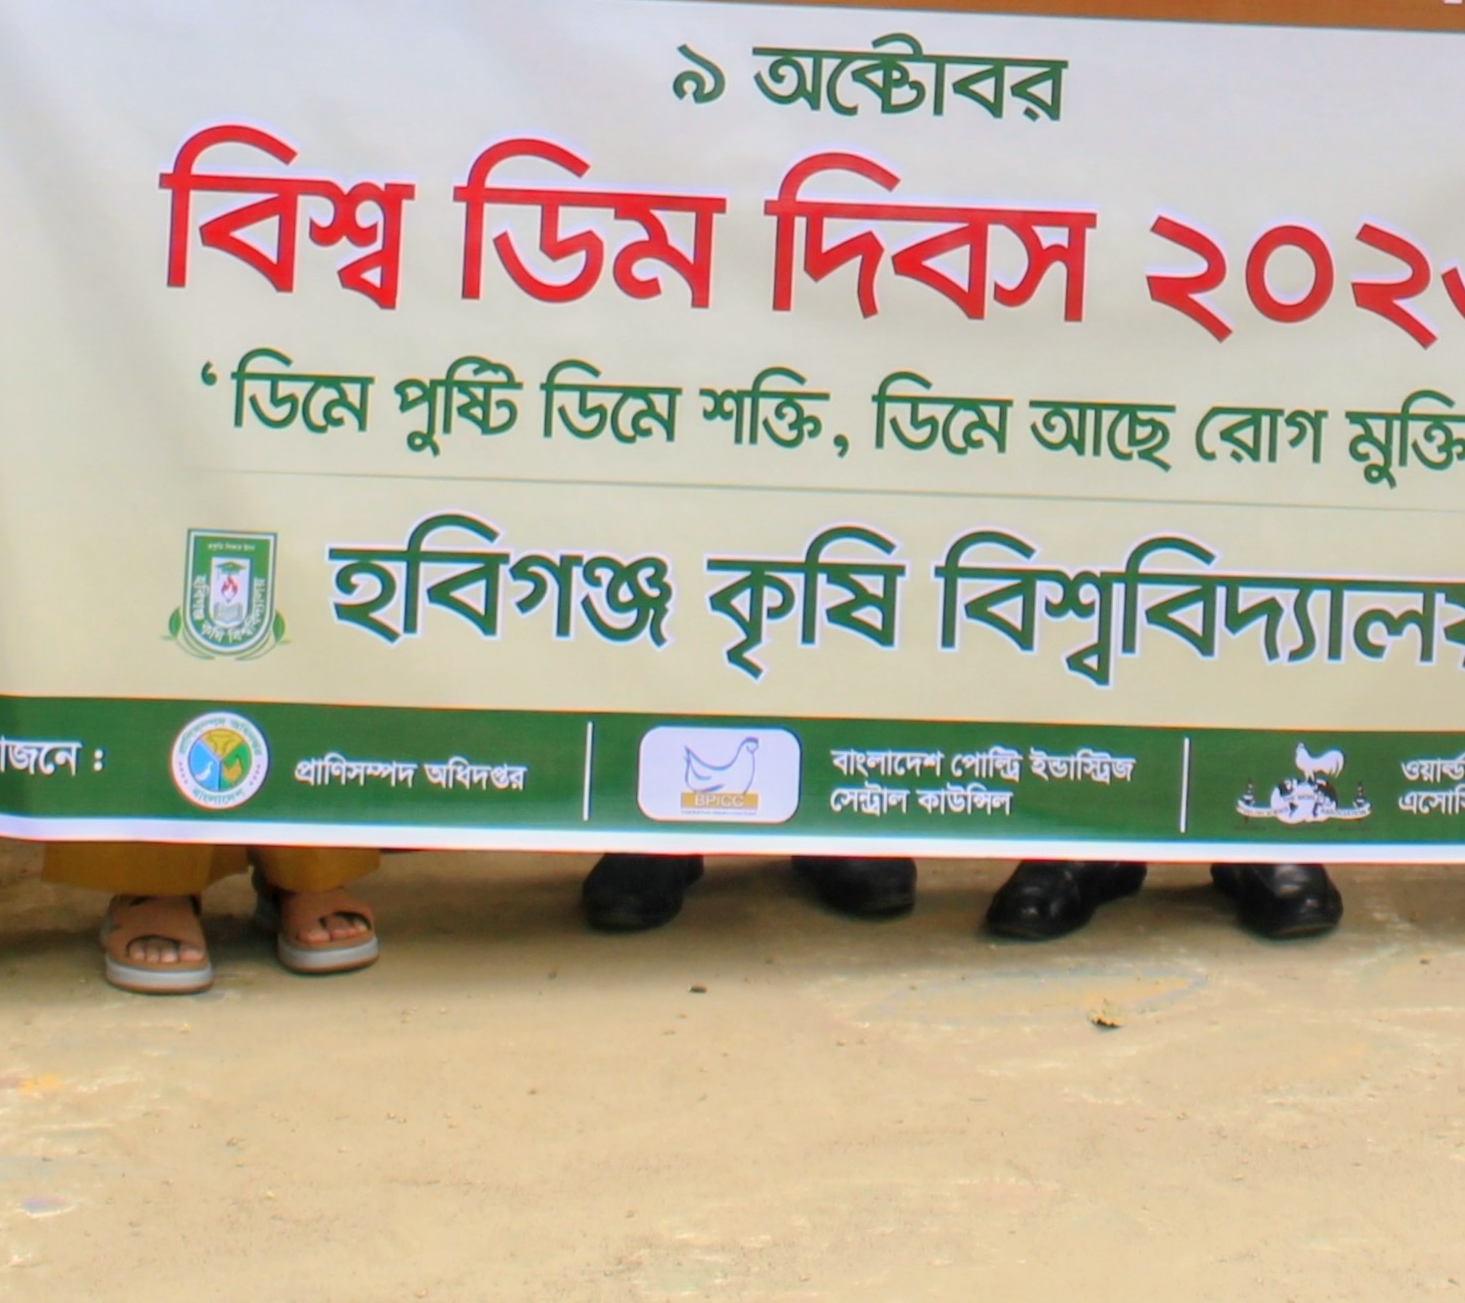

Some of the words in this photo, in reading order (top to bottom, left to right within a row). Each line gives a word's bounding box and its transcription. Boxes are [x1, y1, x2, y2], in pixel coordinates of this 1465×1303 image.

[673, 44, 726, 104] ৯
[752, 32, 1069, 122] অক্টোবর
[158, 124, 415, 311] বিশ্ব
[453, 138, 728, 312] ডিম
[764, 151, 1098, 324] দিবস
[394, 355, 525, 454] পুষ্টি
[541, 361, 679, 445] ডিমে
[701, 365, 850, 457] শক্তি,
[872, 371, 1014, 457] ডিমে
[1031, 397, 1173, 472] আছে
[1193, 401, 1324, 466] রোগ
[331, 512, 673, 650] হবিগঞ্জ
[707, 524, 903, 680] কৃষি
[294, 751, 418, 788] প্রাণিসম্পদ
[423, 756, 528, 791] অধিদপ্তর
[830, 748, 944, 779] বাংলাদেশ
[916, 781, 1015, 816] কাউন্সিল
